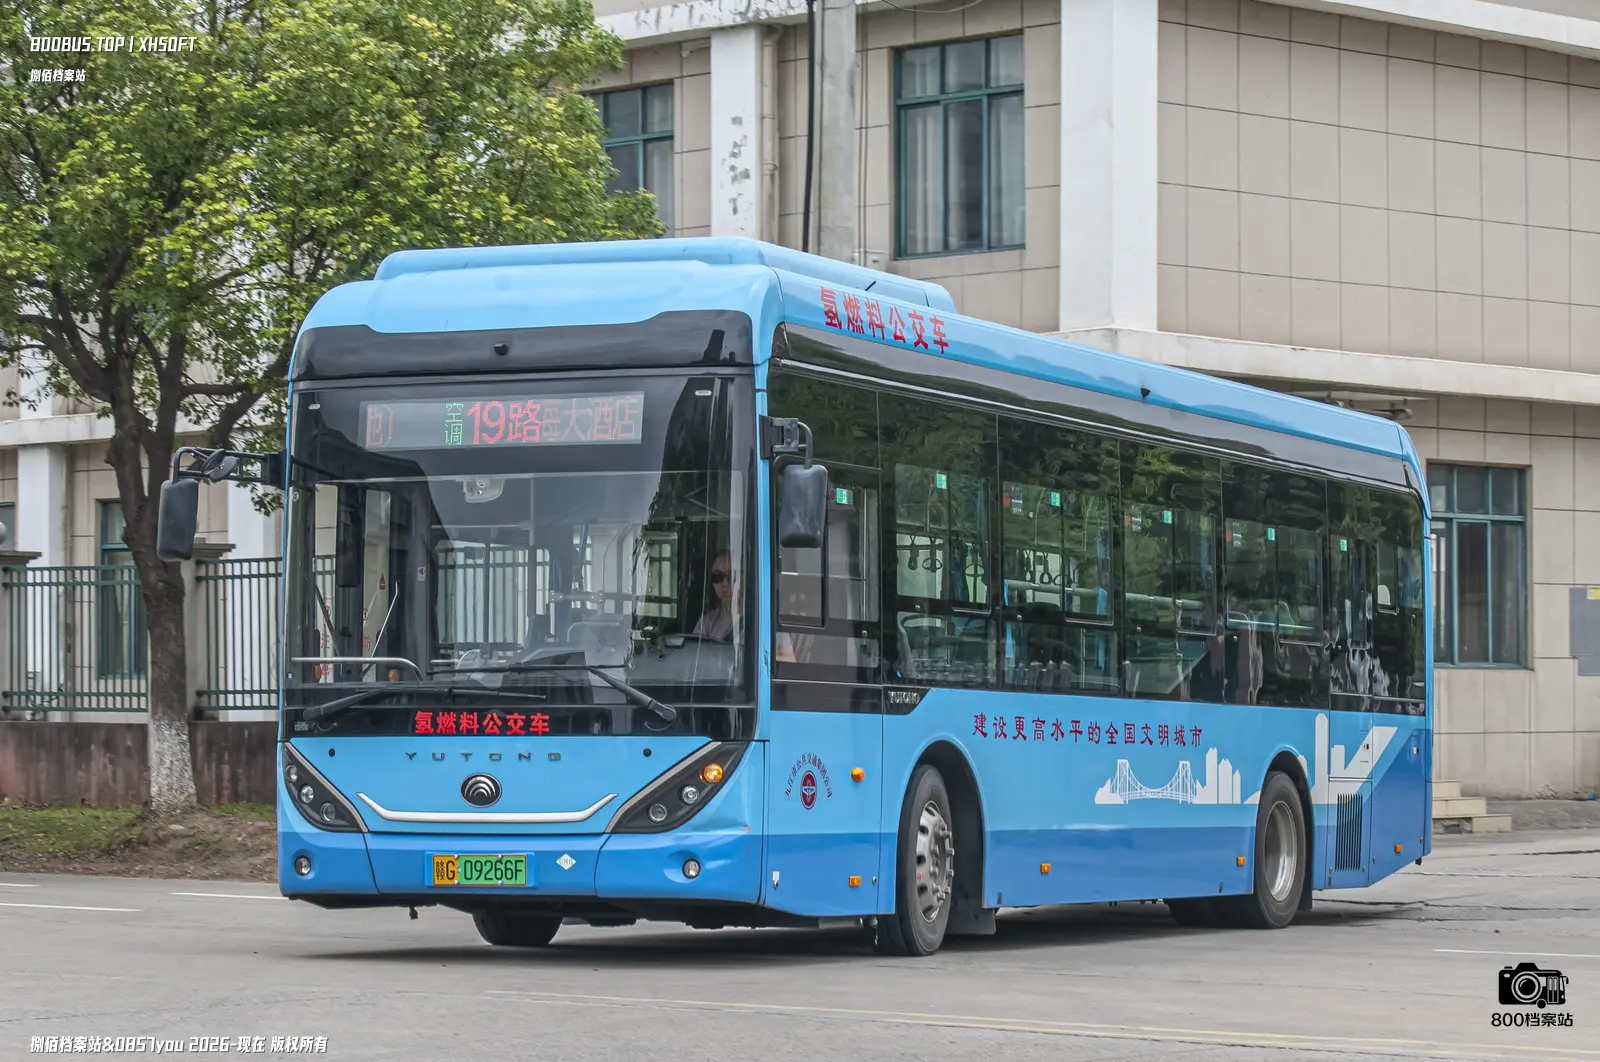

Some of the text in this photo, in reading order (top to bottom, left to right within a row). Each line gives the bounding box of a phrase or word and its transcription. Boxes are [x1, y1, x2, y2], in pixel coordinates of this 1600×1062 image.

[820, 286, 949, 354] 氢燃料公交车
[414, 710, 550, 736] 氢燃料公交车
[972, 712, 1203, 748] 建设更高水平的全国文明城市
[405, 751, 561, 762] YUTONG
